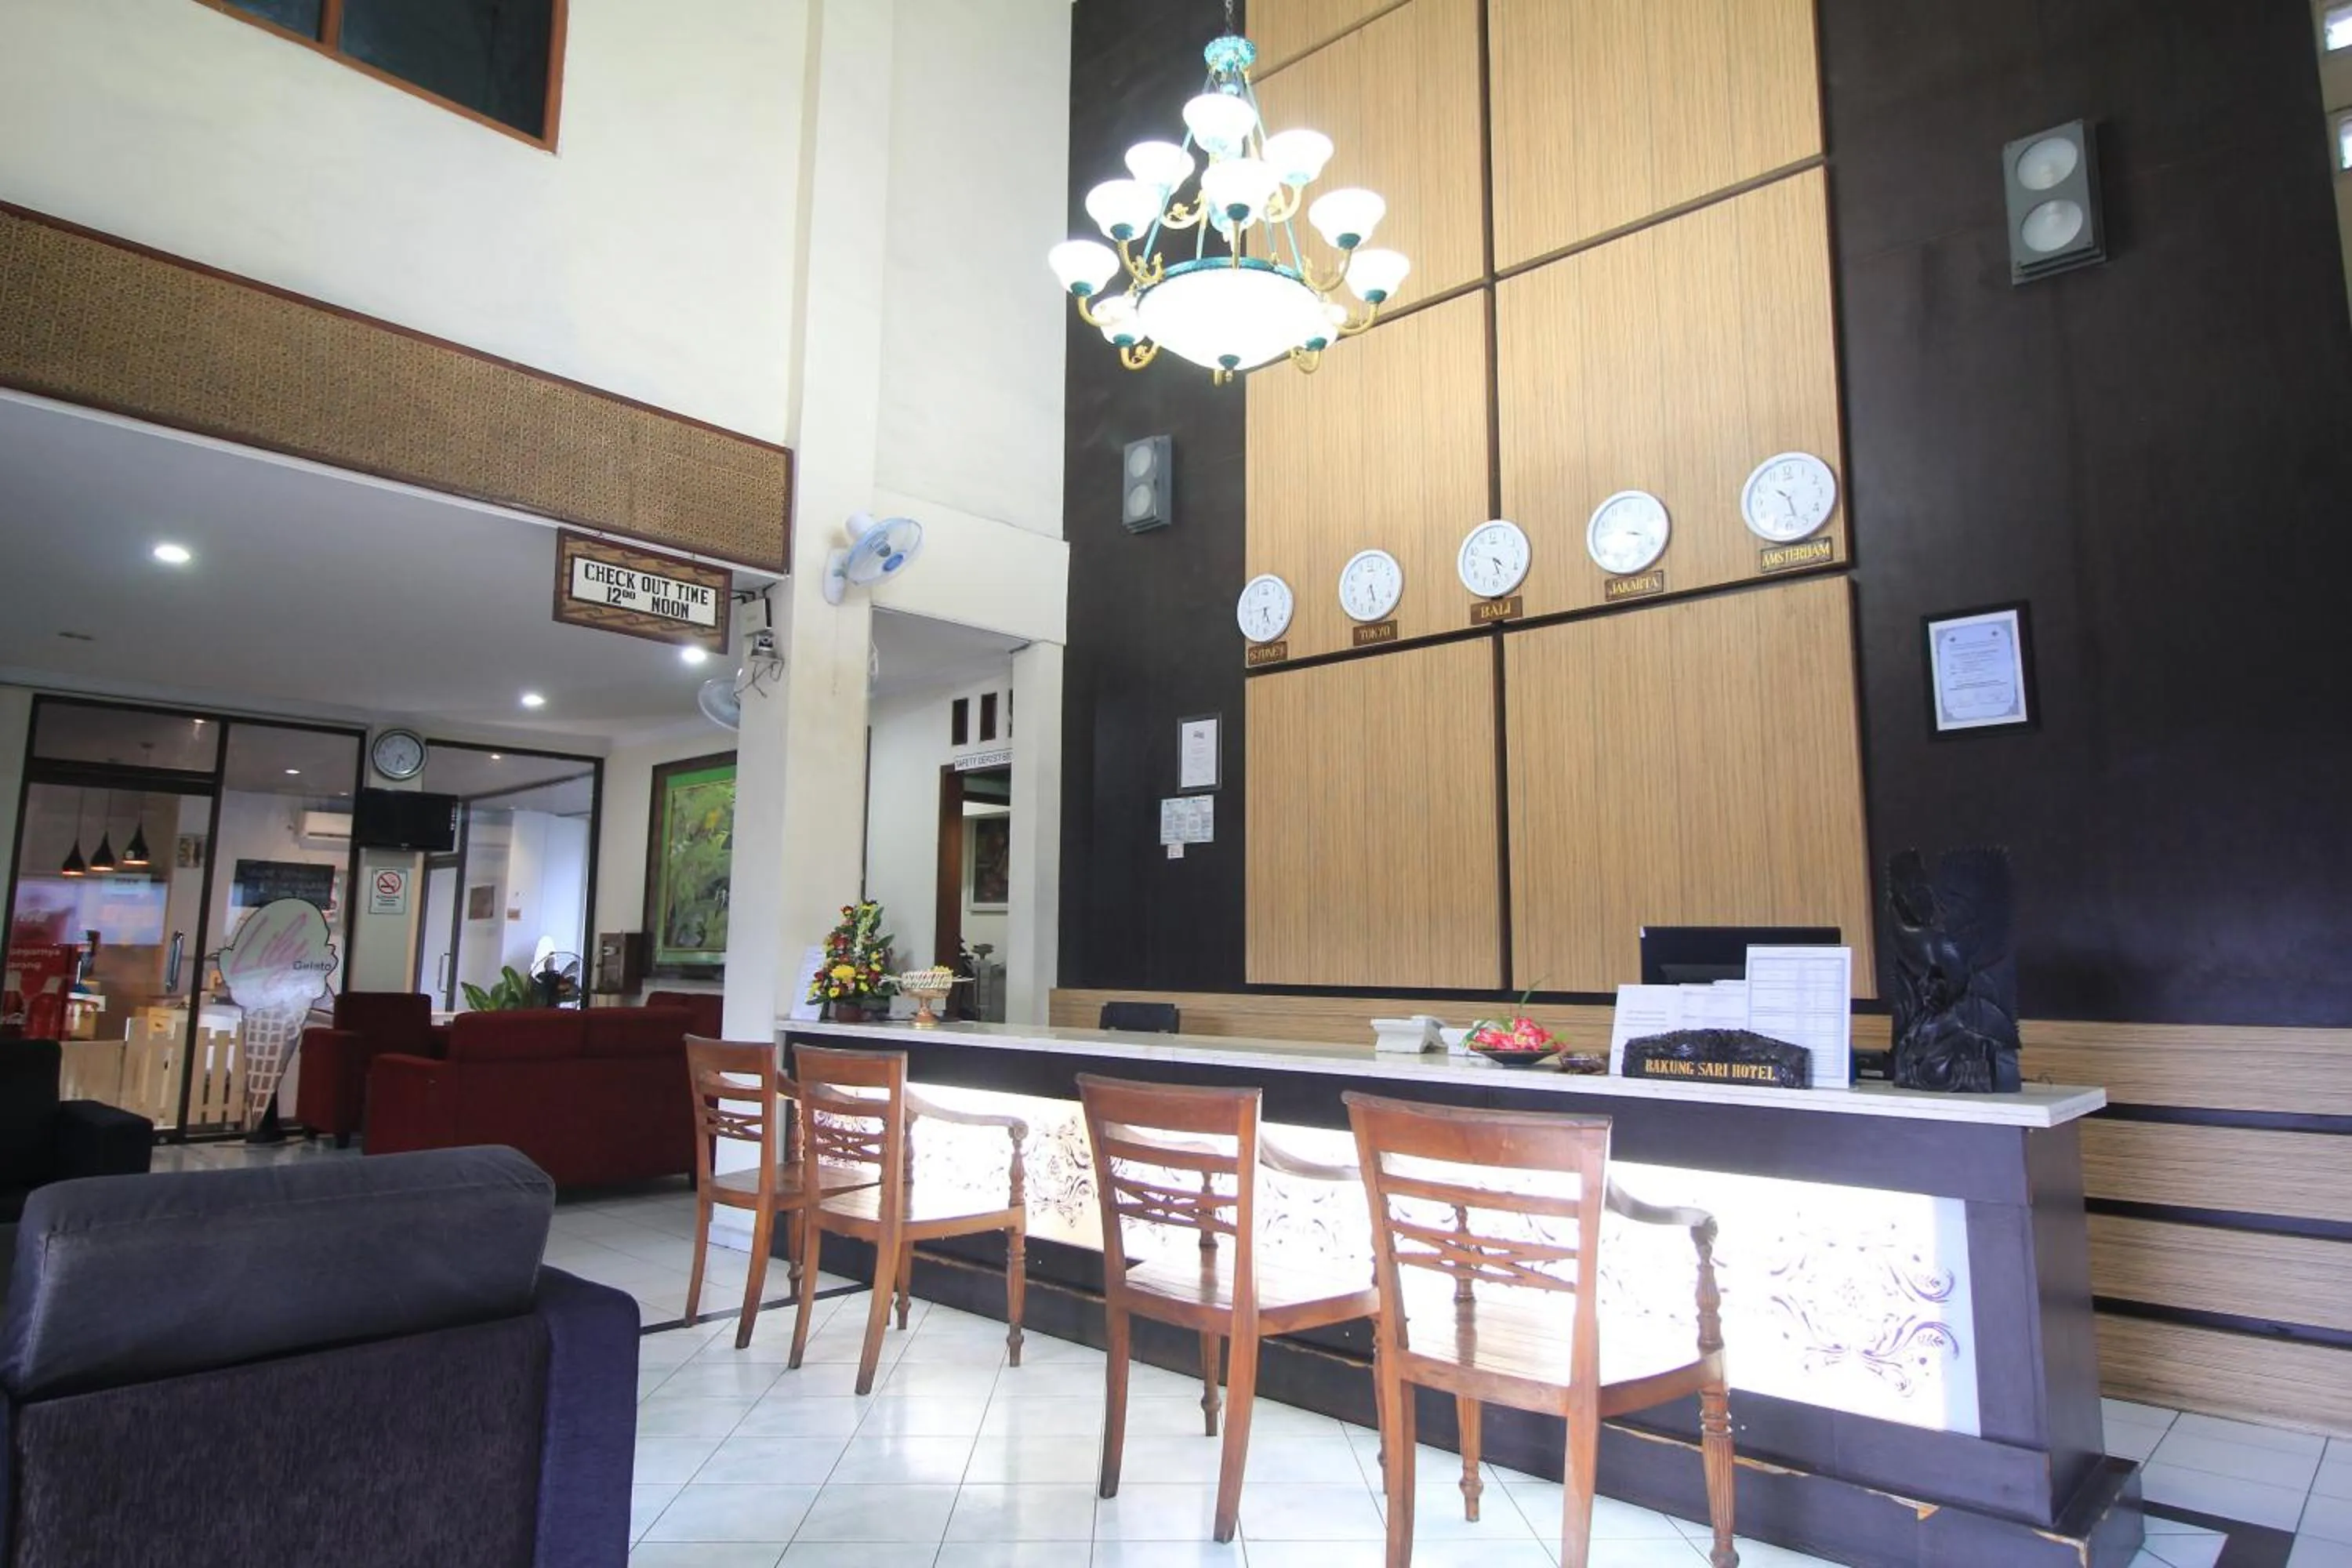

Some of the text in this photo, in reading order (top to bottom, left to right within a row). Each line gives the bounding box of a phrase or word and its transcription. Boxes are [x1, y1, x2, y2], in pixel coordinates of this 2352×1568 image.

[1762, 542, 1831, 568] AMSTERDAM
[584, 562, 709, 605] CHECK OUT TIME
[1611, 576, 1658, 594] JAKARTA
[652, 596, 689, 619] NOON
[1480, 601, 1511, 619] BALI
[1359, 626, 1391, 641] TOKYO
[292, 960, 332, 971] Gelato
[1645, 1058, 1777, 1081] BAKUNG SARI HOTEL
